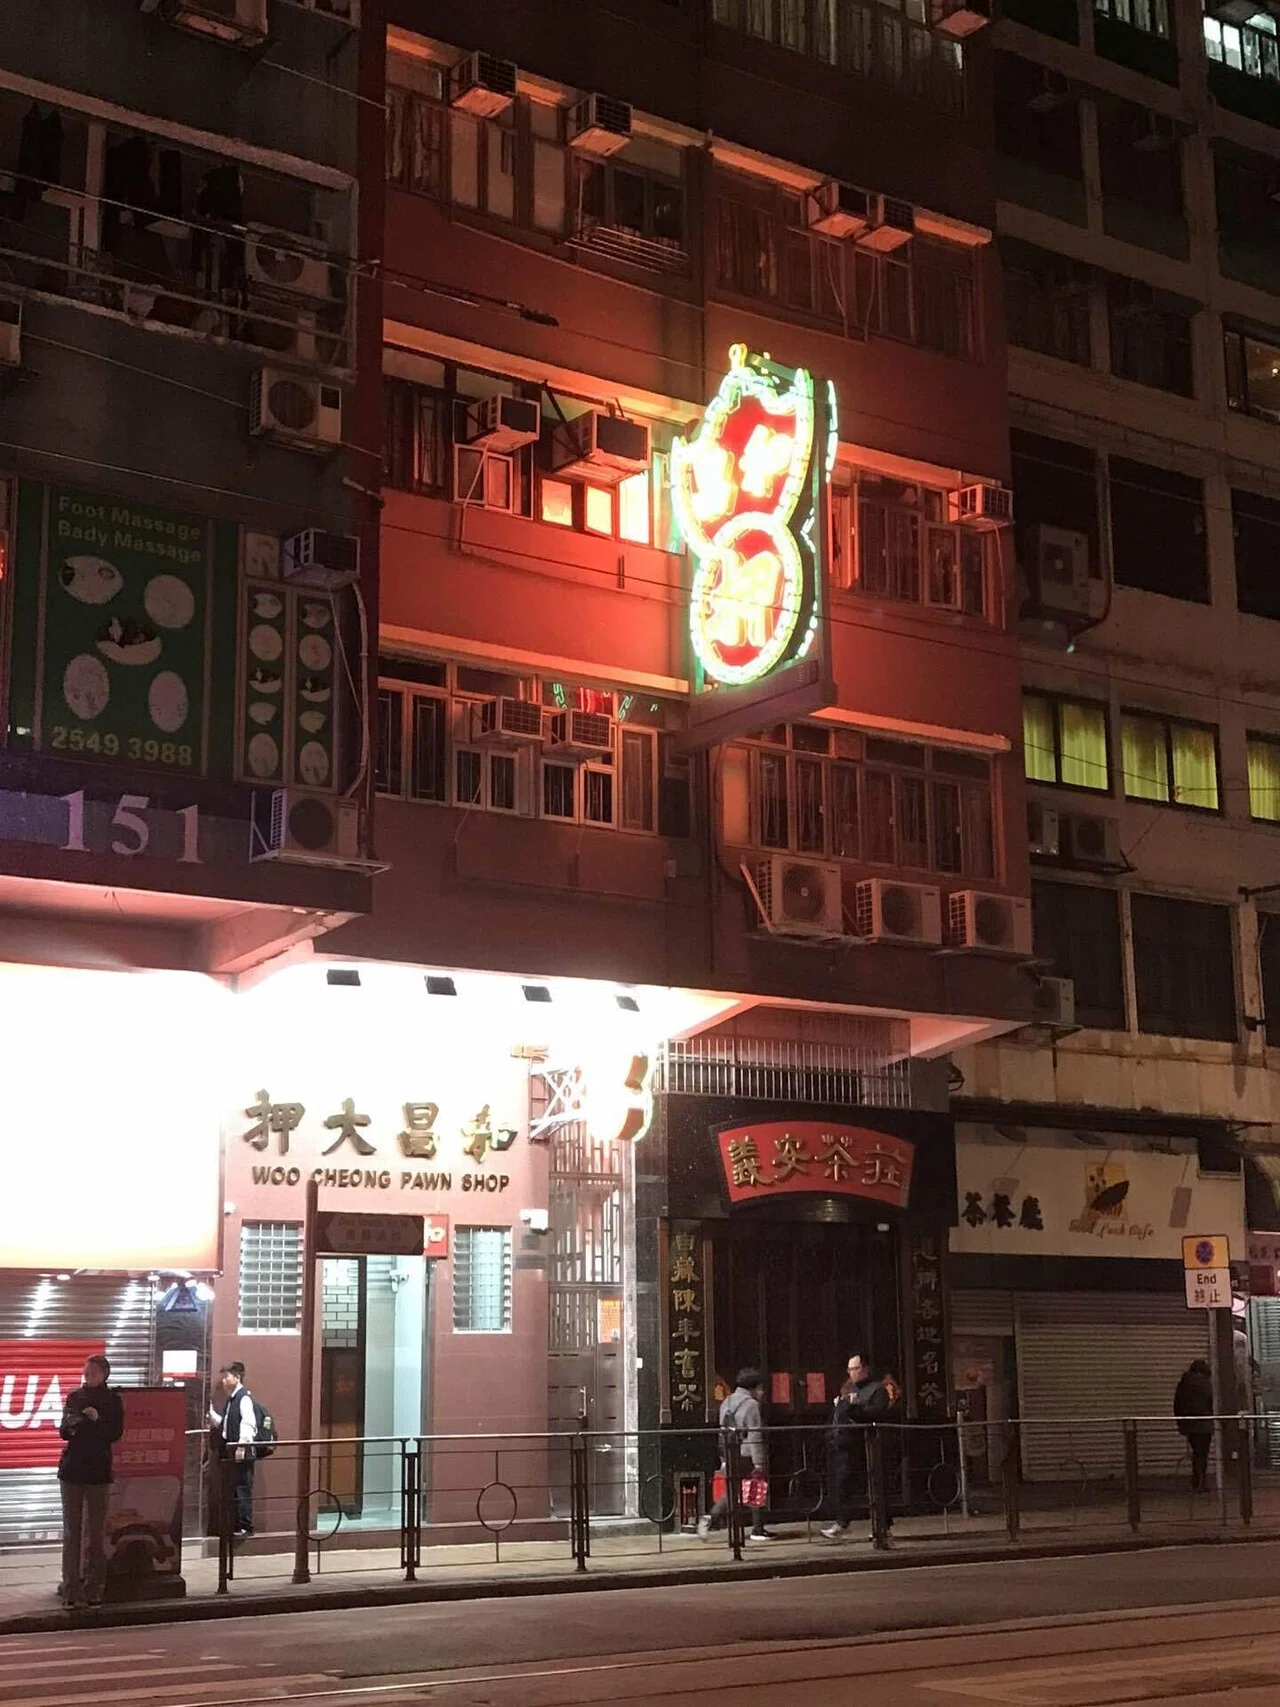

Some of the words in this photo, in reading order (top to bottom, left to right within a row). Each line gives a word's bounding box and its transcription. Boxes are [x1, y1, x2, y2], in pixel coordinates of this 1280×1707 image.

[58, 495, 105, 520] Foot
[111, 505, 201, 541] Massage
[113, 530, 202, 564] Massage
[52, 725, 120, 756] 2549
[128, 733, 193, 766] 3988
[252, 1165, 301, 1186] WOO
[311, 1168, 391, 1189] CHEONG
[400, 1171, 452, 1191] PAWN
[461, 1173, 510, 1193] SHOP
[1196, 1273, 1217, 1285] End
